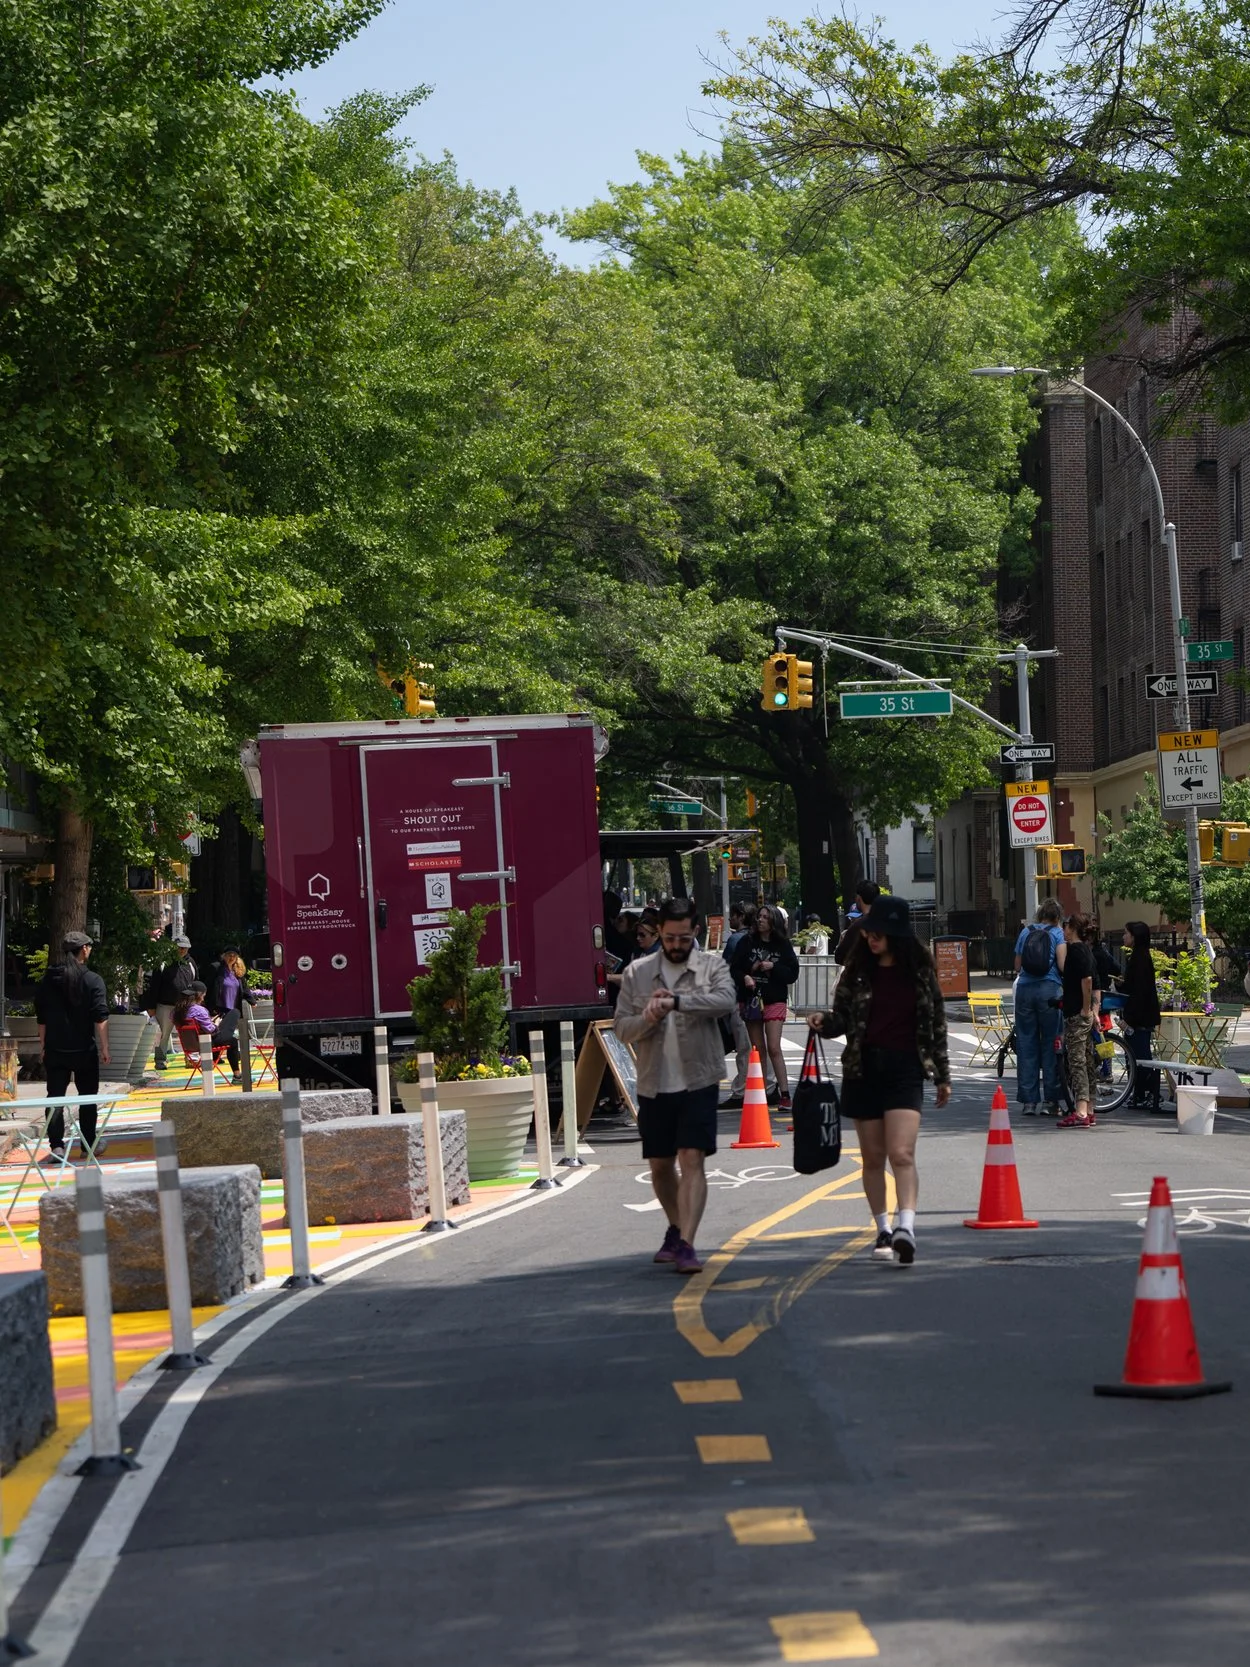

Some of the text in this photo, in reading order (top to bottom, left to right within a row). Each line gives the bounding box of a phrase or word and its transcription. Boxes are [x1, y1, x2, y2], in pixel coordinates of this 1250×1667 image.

[1197, 644, 1223, 658] 35 St
[1157, 680, 1208, 691] ONE WAY
[880, 697, 915, 712] 35 St
[1174, 734, 1202, 747] NEW
[1177, 751, 1202, 763] ALL
[1173, 765, 1208, 776] TRAFFIC
[1017, 784, 1038, 794] NEW
[1167, 792, 1218, 802] EXCEPT BIKES
[404, 814, 461, 825] SHOUT OUT
[297, 908, 344, 919] SpeakEasy
